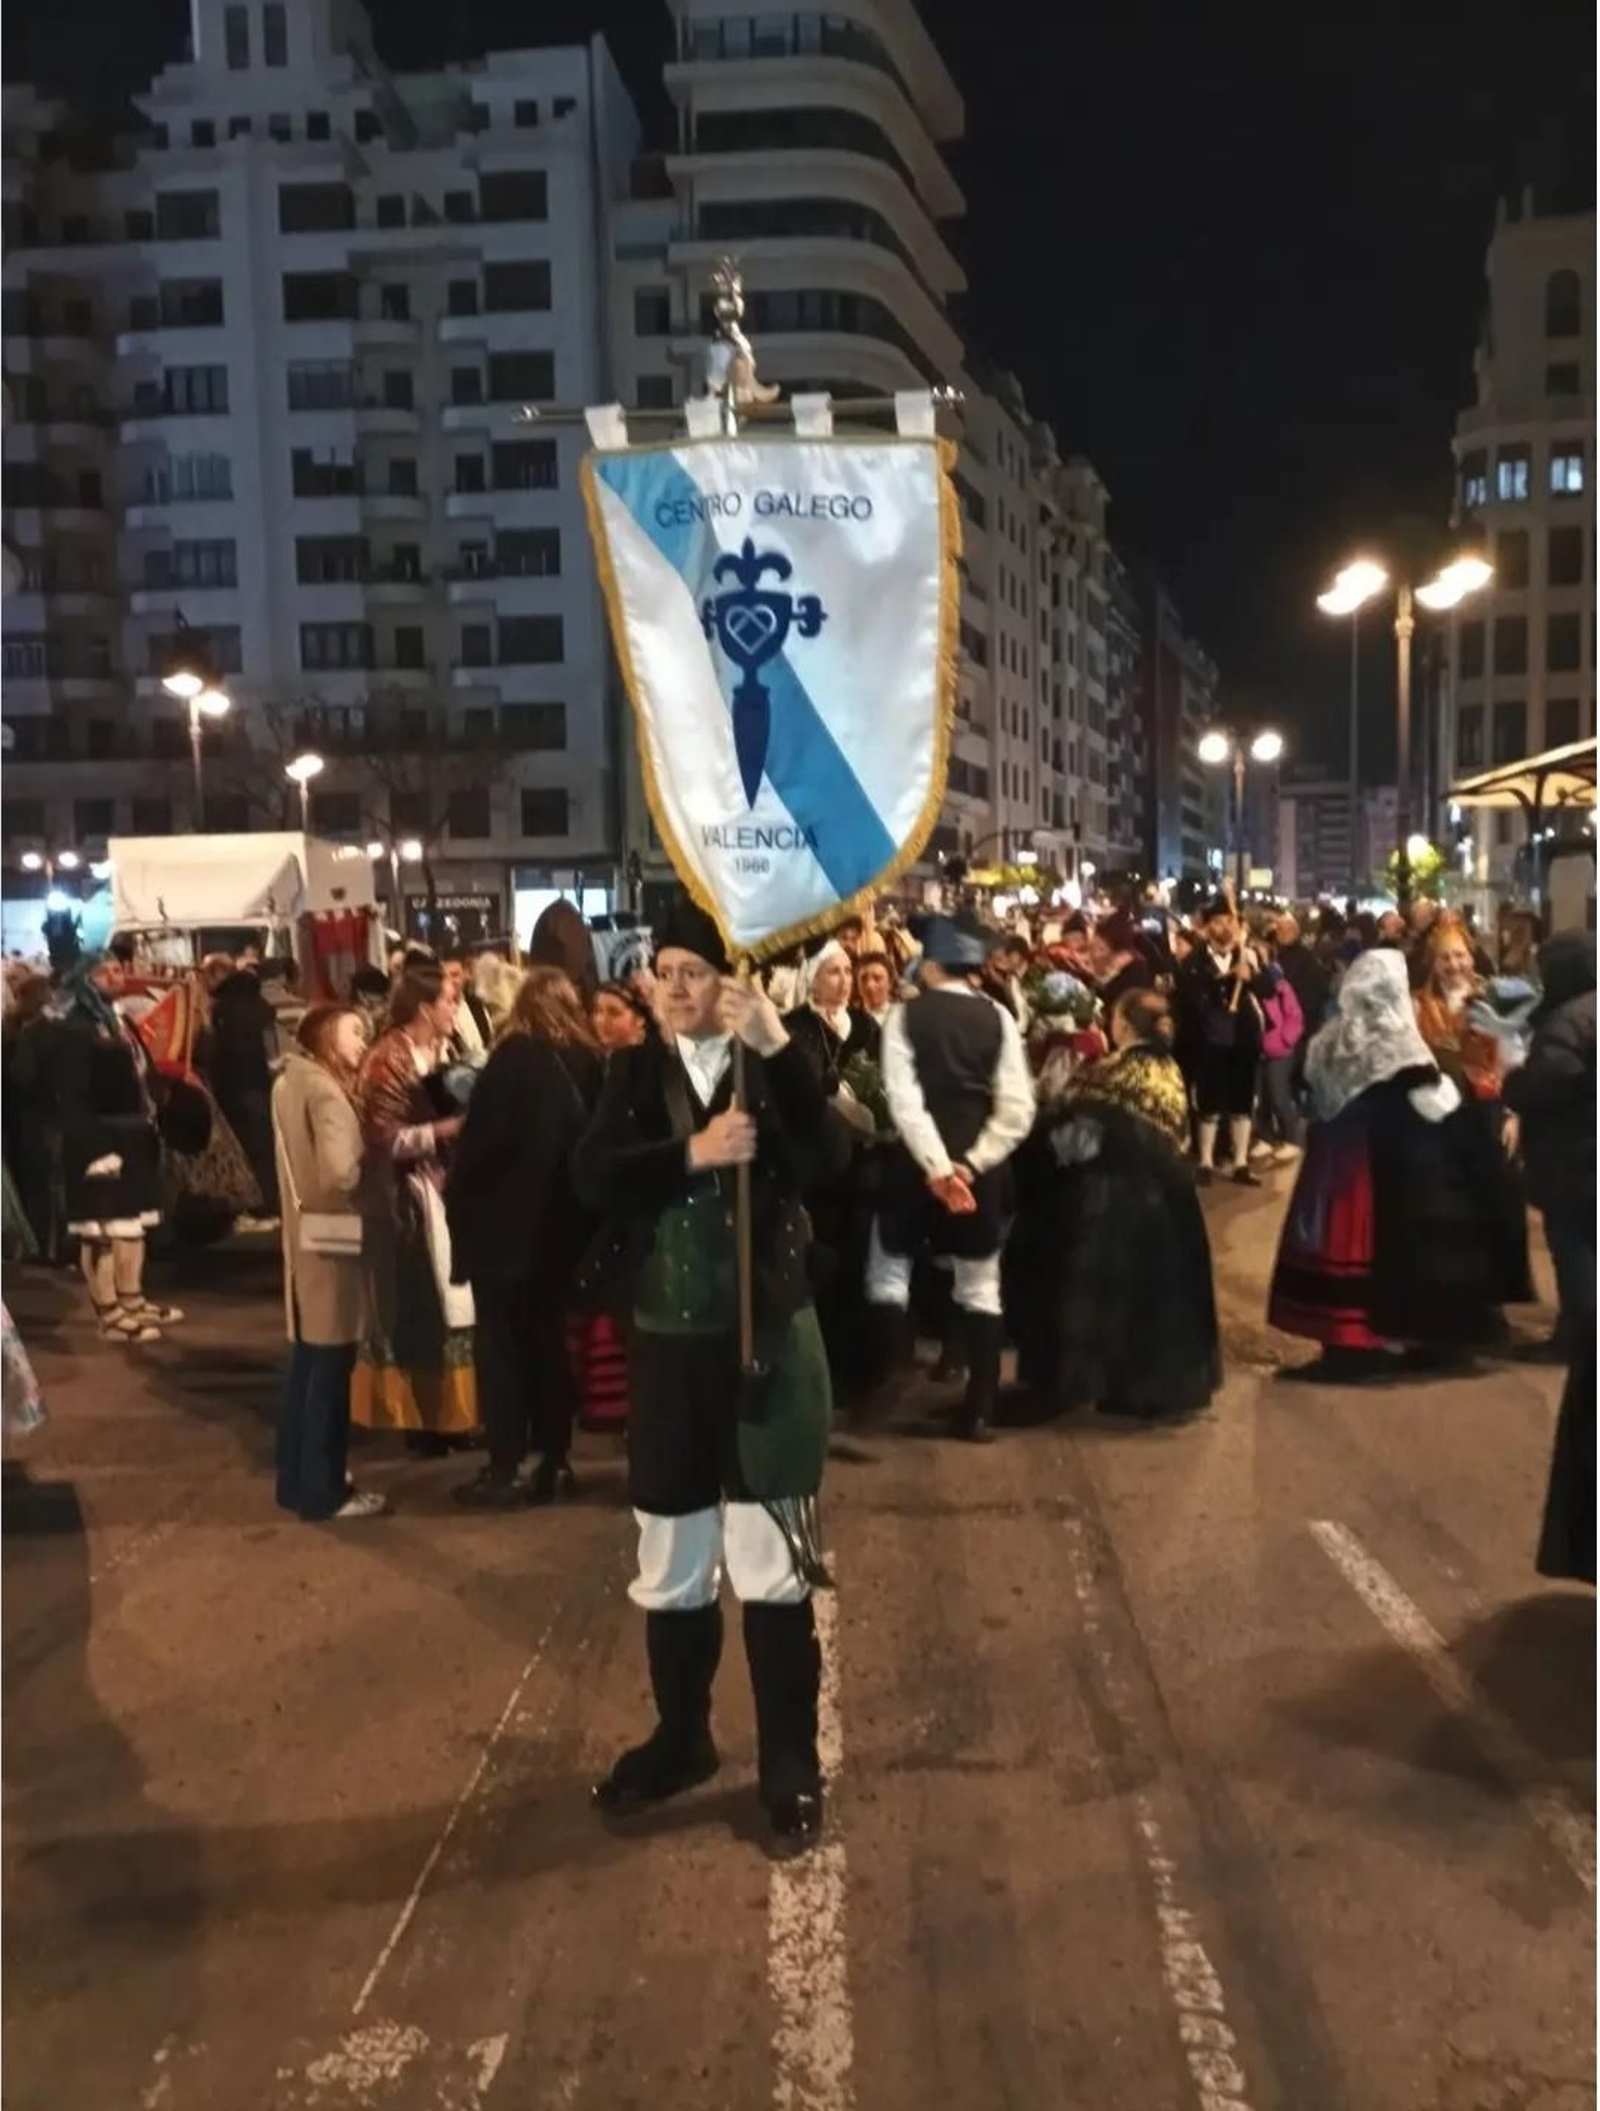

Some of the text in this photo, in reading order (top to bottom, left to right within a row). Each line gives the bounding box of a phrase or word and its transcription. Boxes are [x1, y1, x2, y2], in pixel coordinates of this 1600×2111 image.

[654, 491, 873, 529] CENTRO GALEGO
[701, 825, 819, 850] VALENCIA
